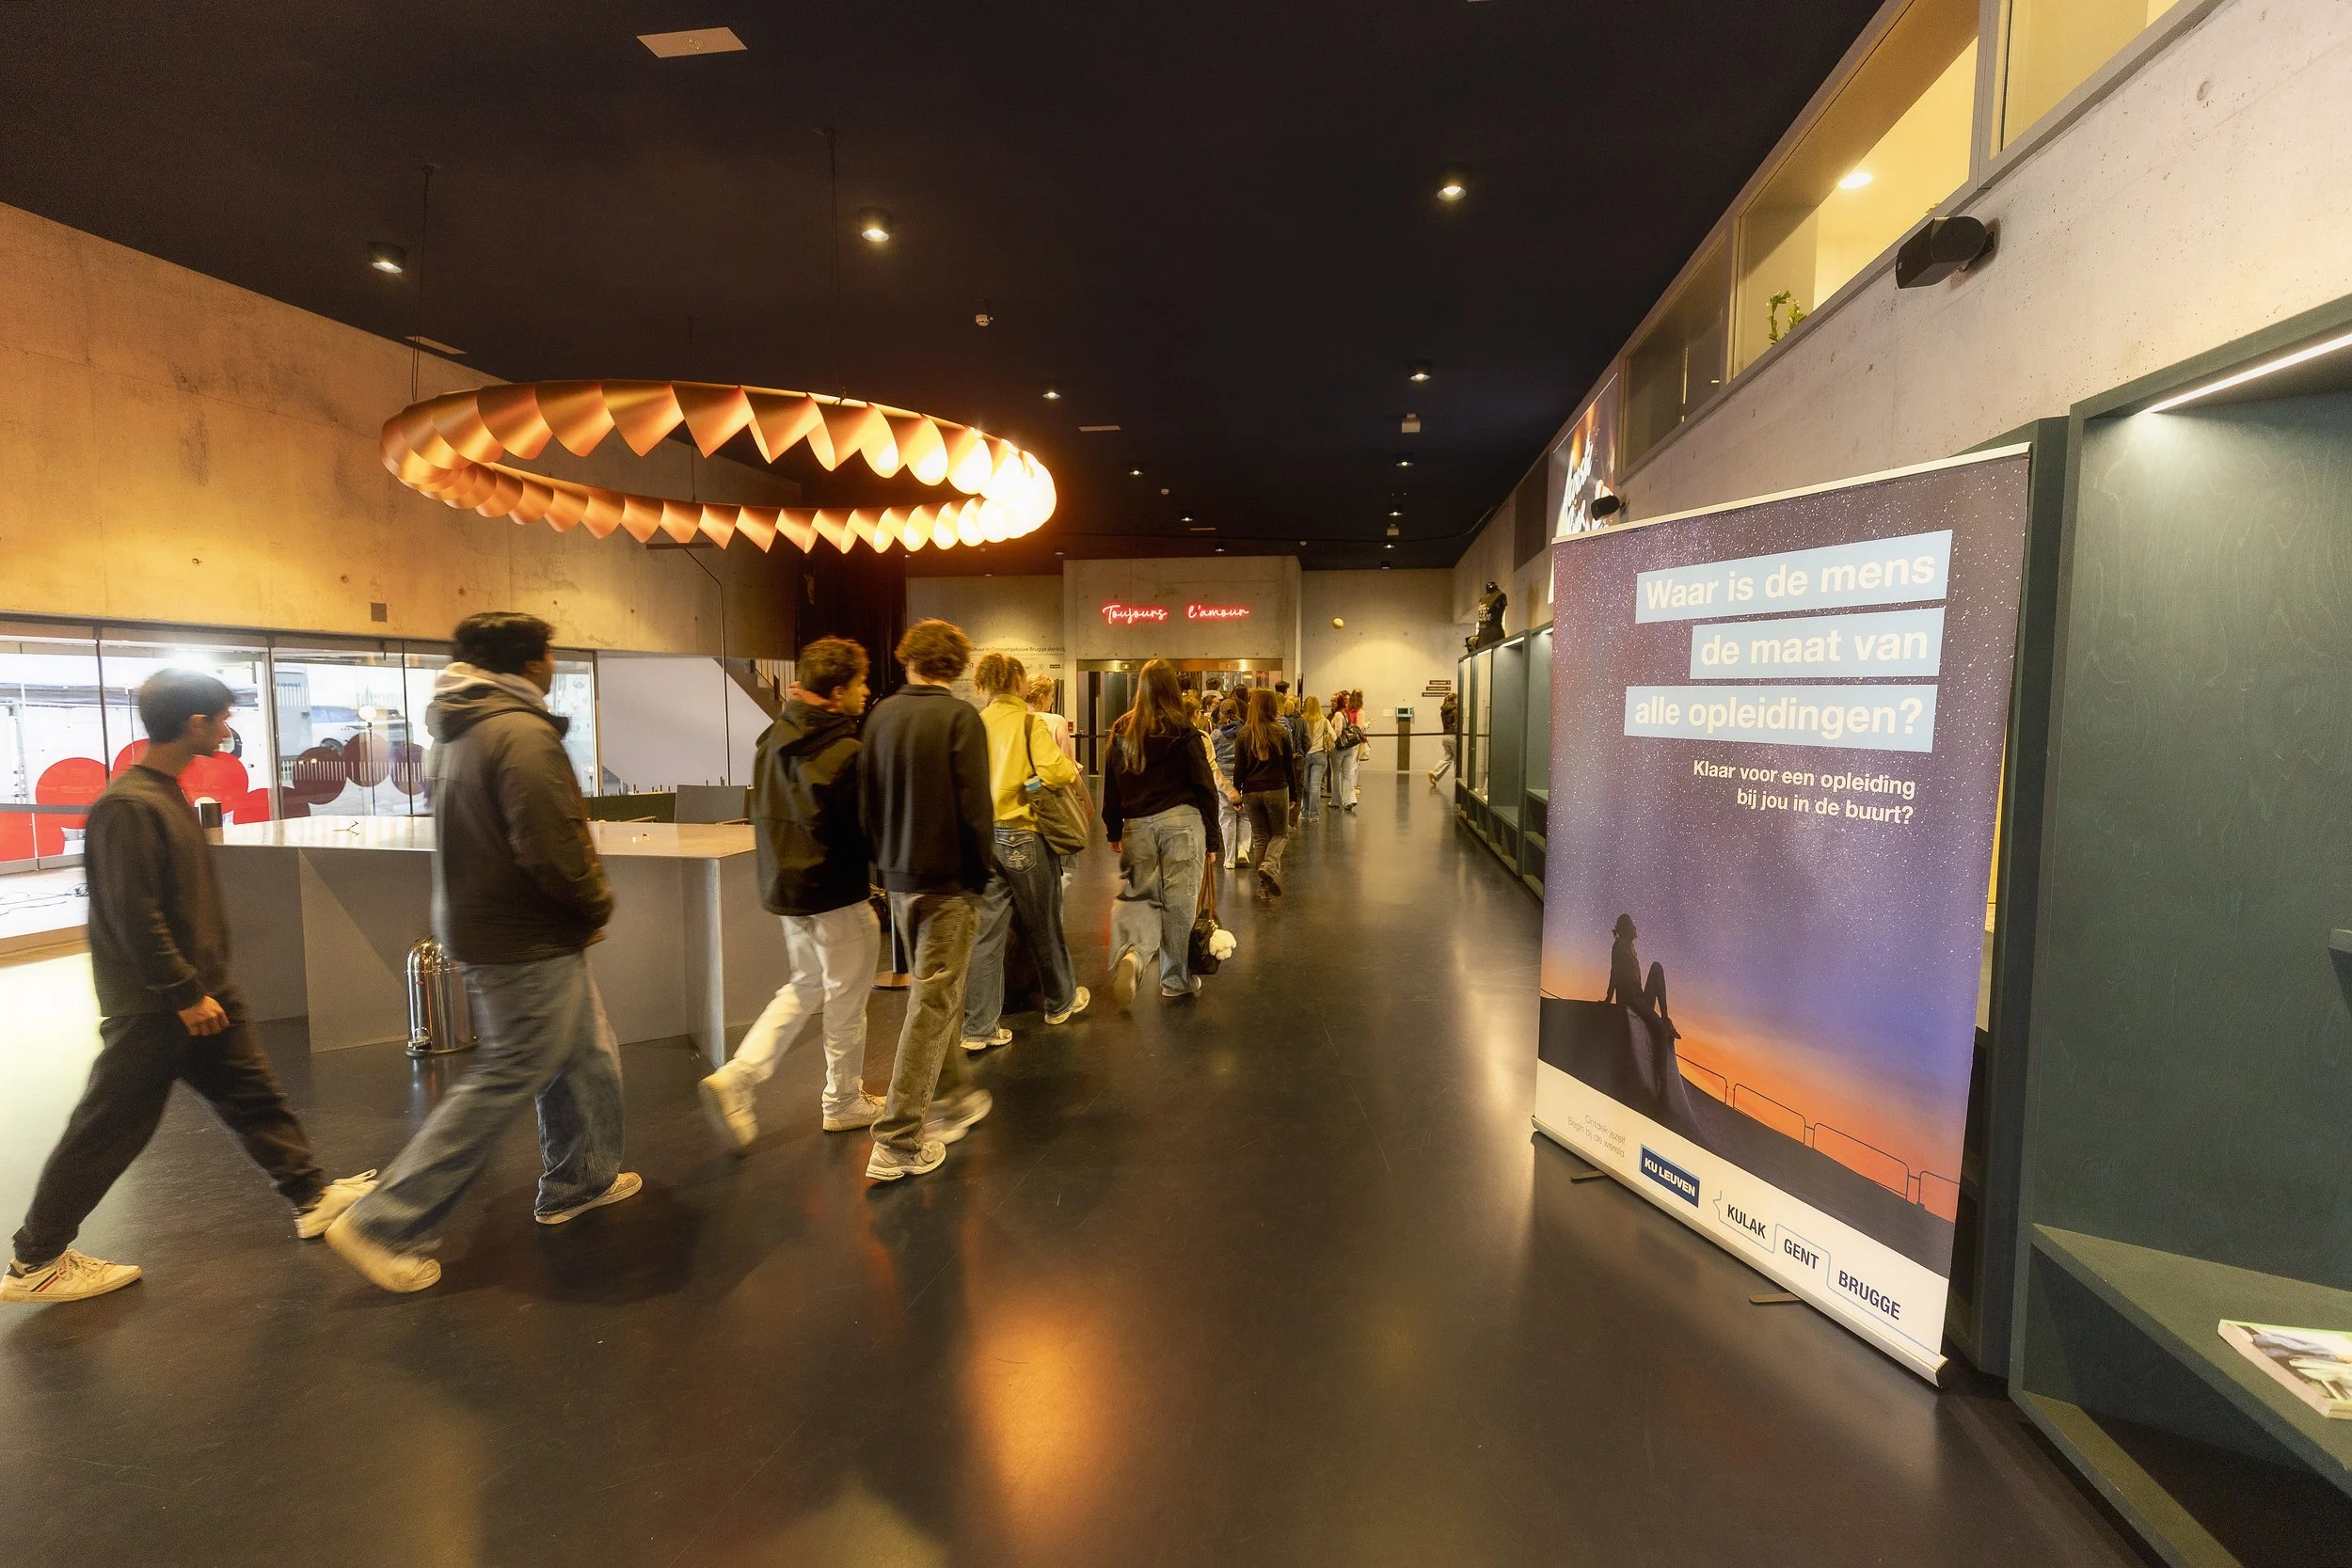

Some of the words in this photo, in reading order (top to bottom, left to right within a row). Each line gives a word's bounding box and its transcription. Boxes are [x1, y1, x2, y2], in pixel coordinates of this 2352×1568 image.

[1646, 578, 1719, 610] Waar
[1727, 571, 1755, 602] is
[1765, 564, 1808, 599] de
[1820, 555, 1935, 594] mens
[1103, 605, 1168, 624] Toujours
[1188, 605, 1249, 619] l'amour
[1700, 635, 1740, 666] de
[1751, 629, 1842, 664] maat
[1853, 630, 1928, 661] van
[1635, 696, 1680, 725] alle
[1689, 697, 1923, 740] opleidingen?
[1693, 760, 1736, 779] Klaar
[1740, 767, 1777, 783] voor
[1782, 770, 1815, 786] een
[1820, 772, 1915, 800] opleiding
[1737, 788, 1756, 810] bij
[1760, 791, 1788, 811] jou
[1793, 795, 1809, 813] in
[1815, 798, 1840, 816] de
[1845, 800, 1914, 825] buurt?
[1567, 1116, 1584, 1132] Begin
[1594, 1133, 1602, 1144] de
[1584, 1115, 1608, 1134] Ontdek
[1645, 1157, 1658, 1174] KU
[1659, 1165, 1695, 1197] LEUVEN
[1727, 1204, 1766, 1239] KULAK
[1784, 1238, 1820, 1270] GENT
[1838, 1270, 1901, 1320] BRUGGE
